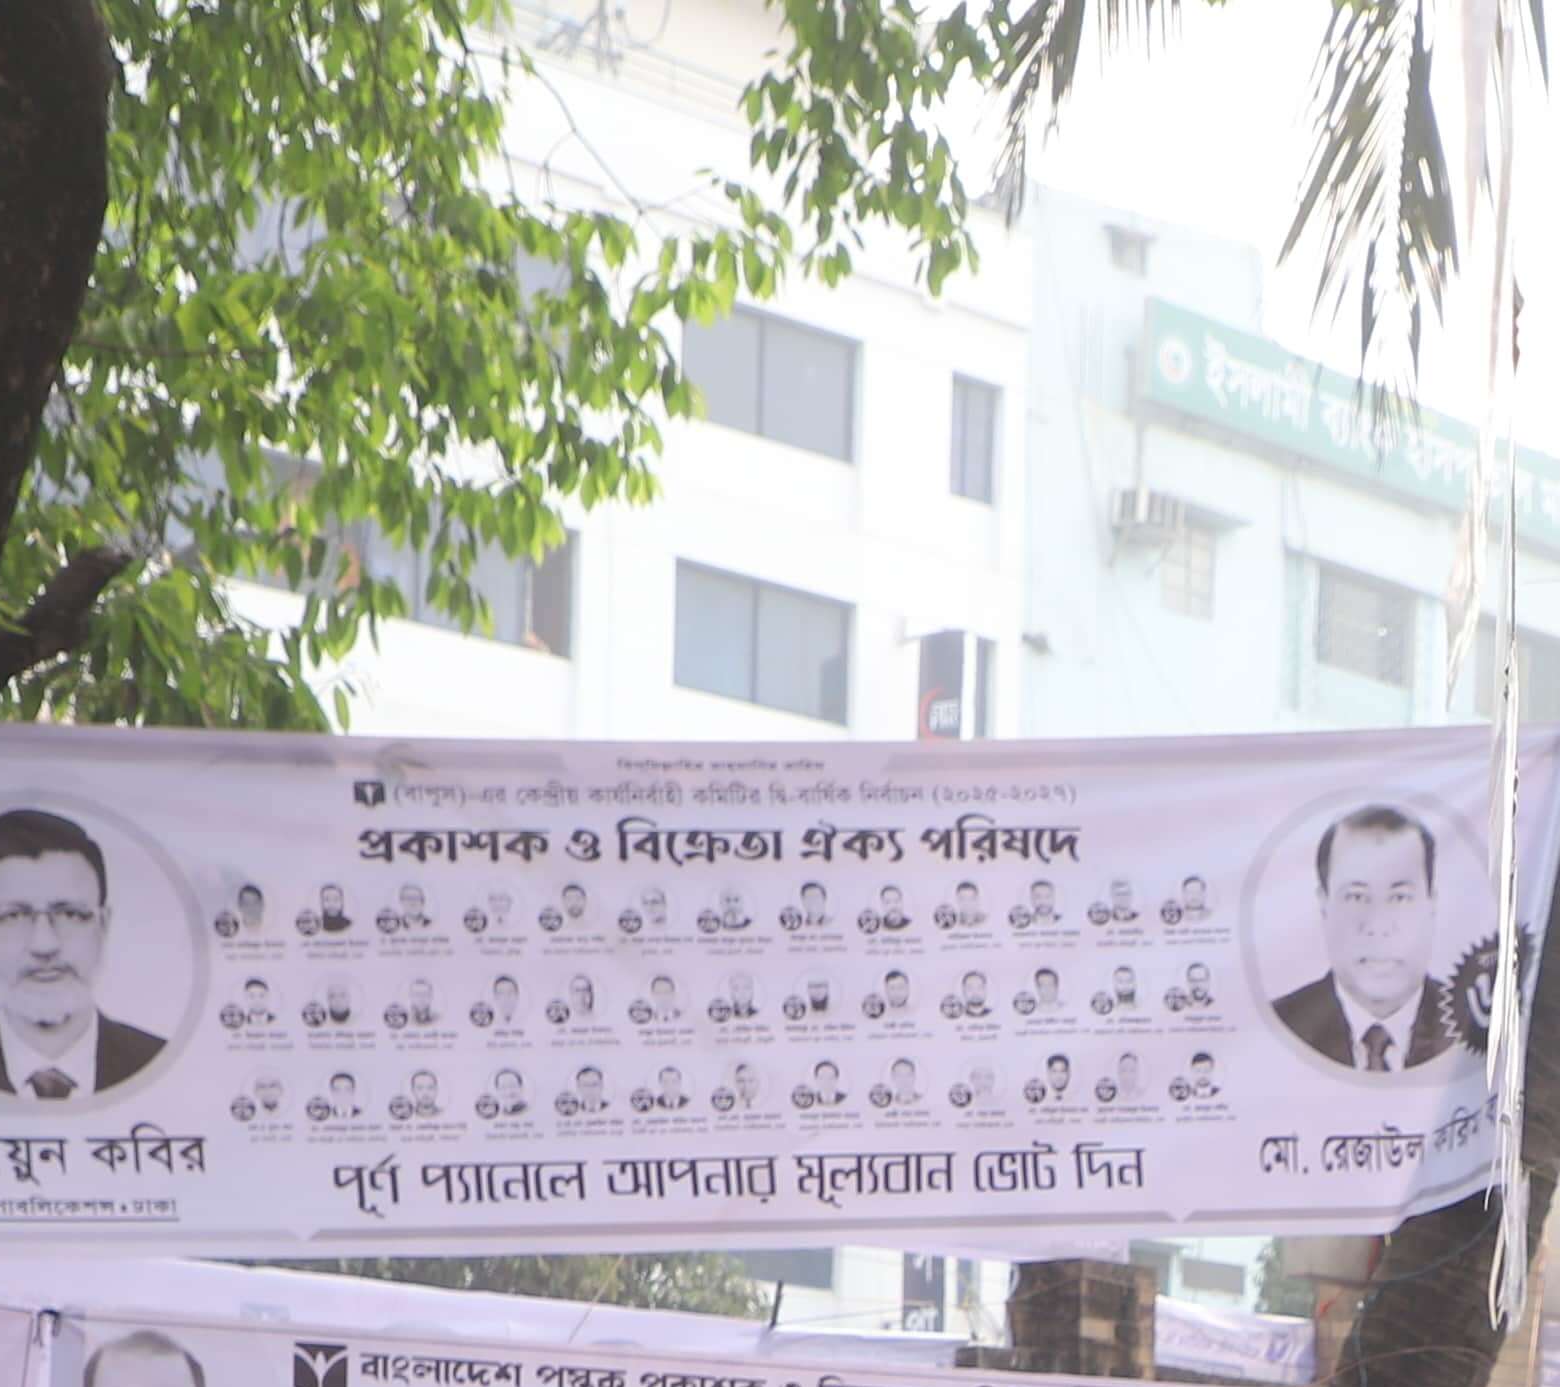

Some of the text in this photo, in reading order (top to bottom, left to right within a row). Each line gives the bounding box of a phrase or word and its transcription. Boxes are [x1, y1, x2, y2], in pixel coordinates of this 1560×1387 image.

[358, 813, 1081, 866] প্রকাশক ও বিক্রেতা ঐক্য পরিষদে
[87, 1123, 206, 1174] কবির
[1260, 1123, 1425, 1174] মো. রেজাউল
[333, 1141, 1145, 1217] পূর্ণ প্যানেলে আপনার মূল্যবান ভোট দিন
